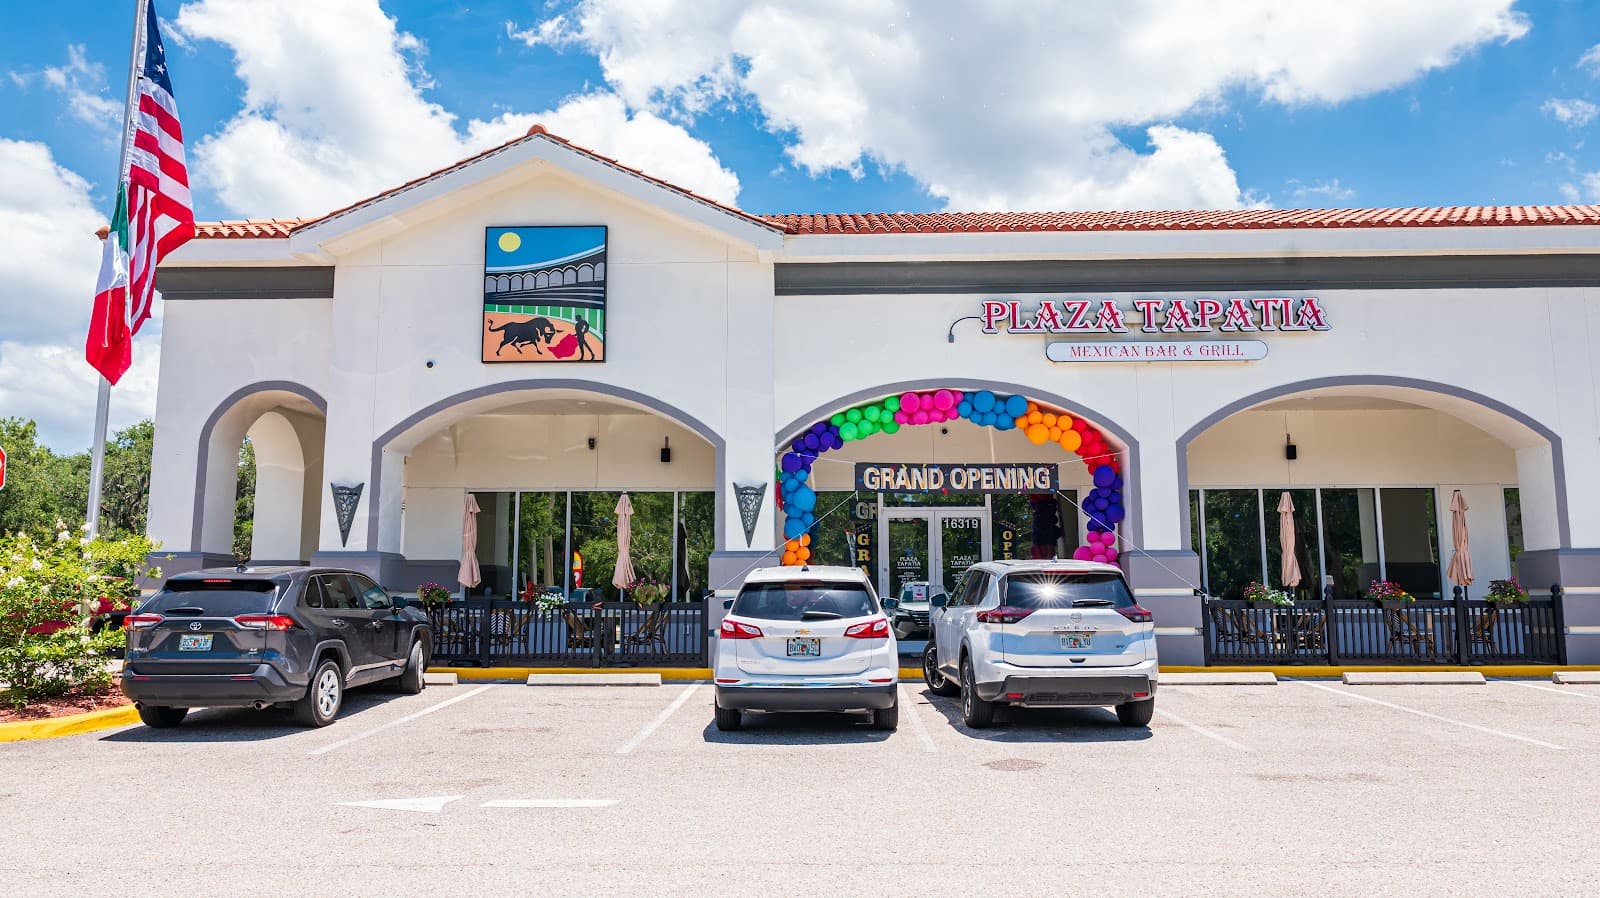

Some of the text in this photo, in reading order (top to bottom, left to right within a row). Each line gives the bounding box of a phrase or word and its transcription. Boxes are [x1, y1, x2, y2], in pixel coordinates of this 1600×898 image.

[980, 297, 1332, 334] PLAZA TAPATIA
[1070, 344, 1244, 358] MEXICAN BAR & GRILL
[863, 466, 1051, 490] GRAND OPENING
[943, 518, 979, 529] 16319
